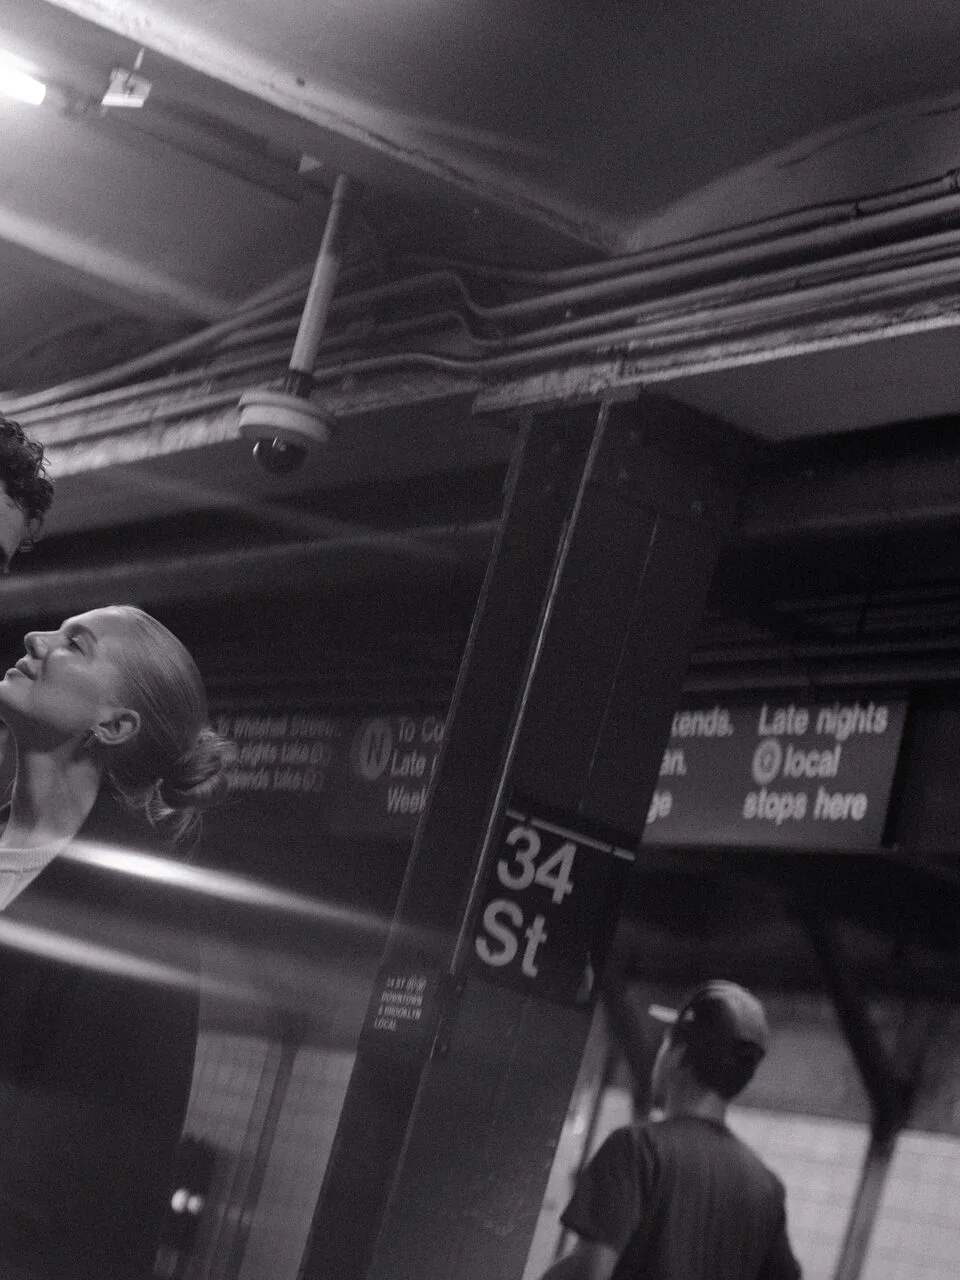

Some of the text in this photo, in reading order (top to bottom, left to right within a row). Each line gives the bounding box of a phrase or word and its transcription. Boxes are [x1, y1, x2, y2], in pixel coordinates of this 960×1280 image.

[397, 715, 416, 743] To
[758, 701, 888, 741] Late nights
[390, 747, 426, 777] Late
[783, 742, 842, 777] local
[743, 785, 869, 826] stops here
[497, 825, 577, 905] 34
[475, 898, 547, 979] St
